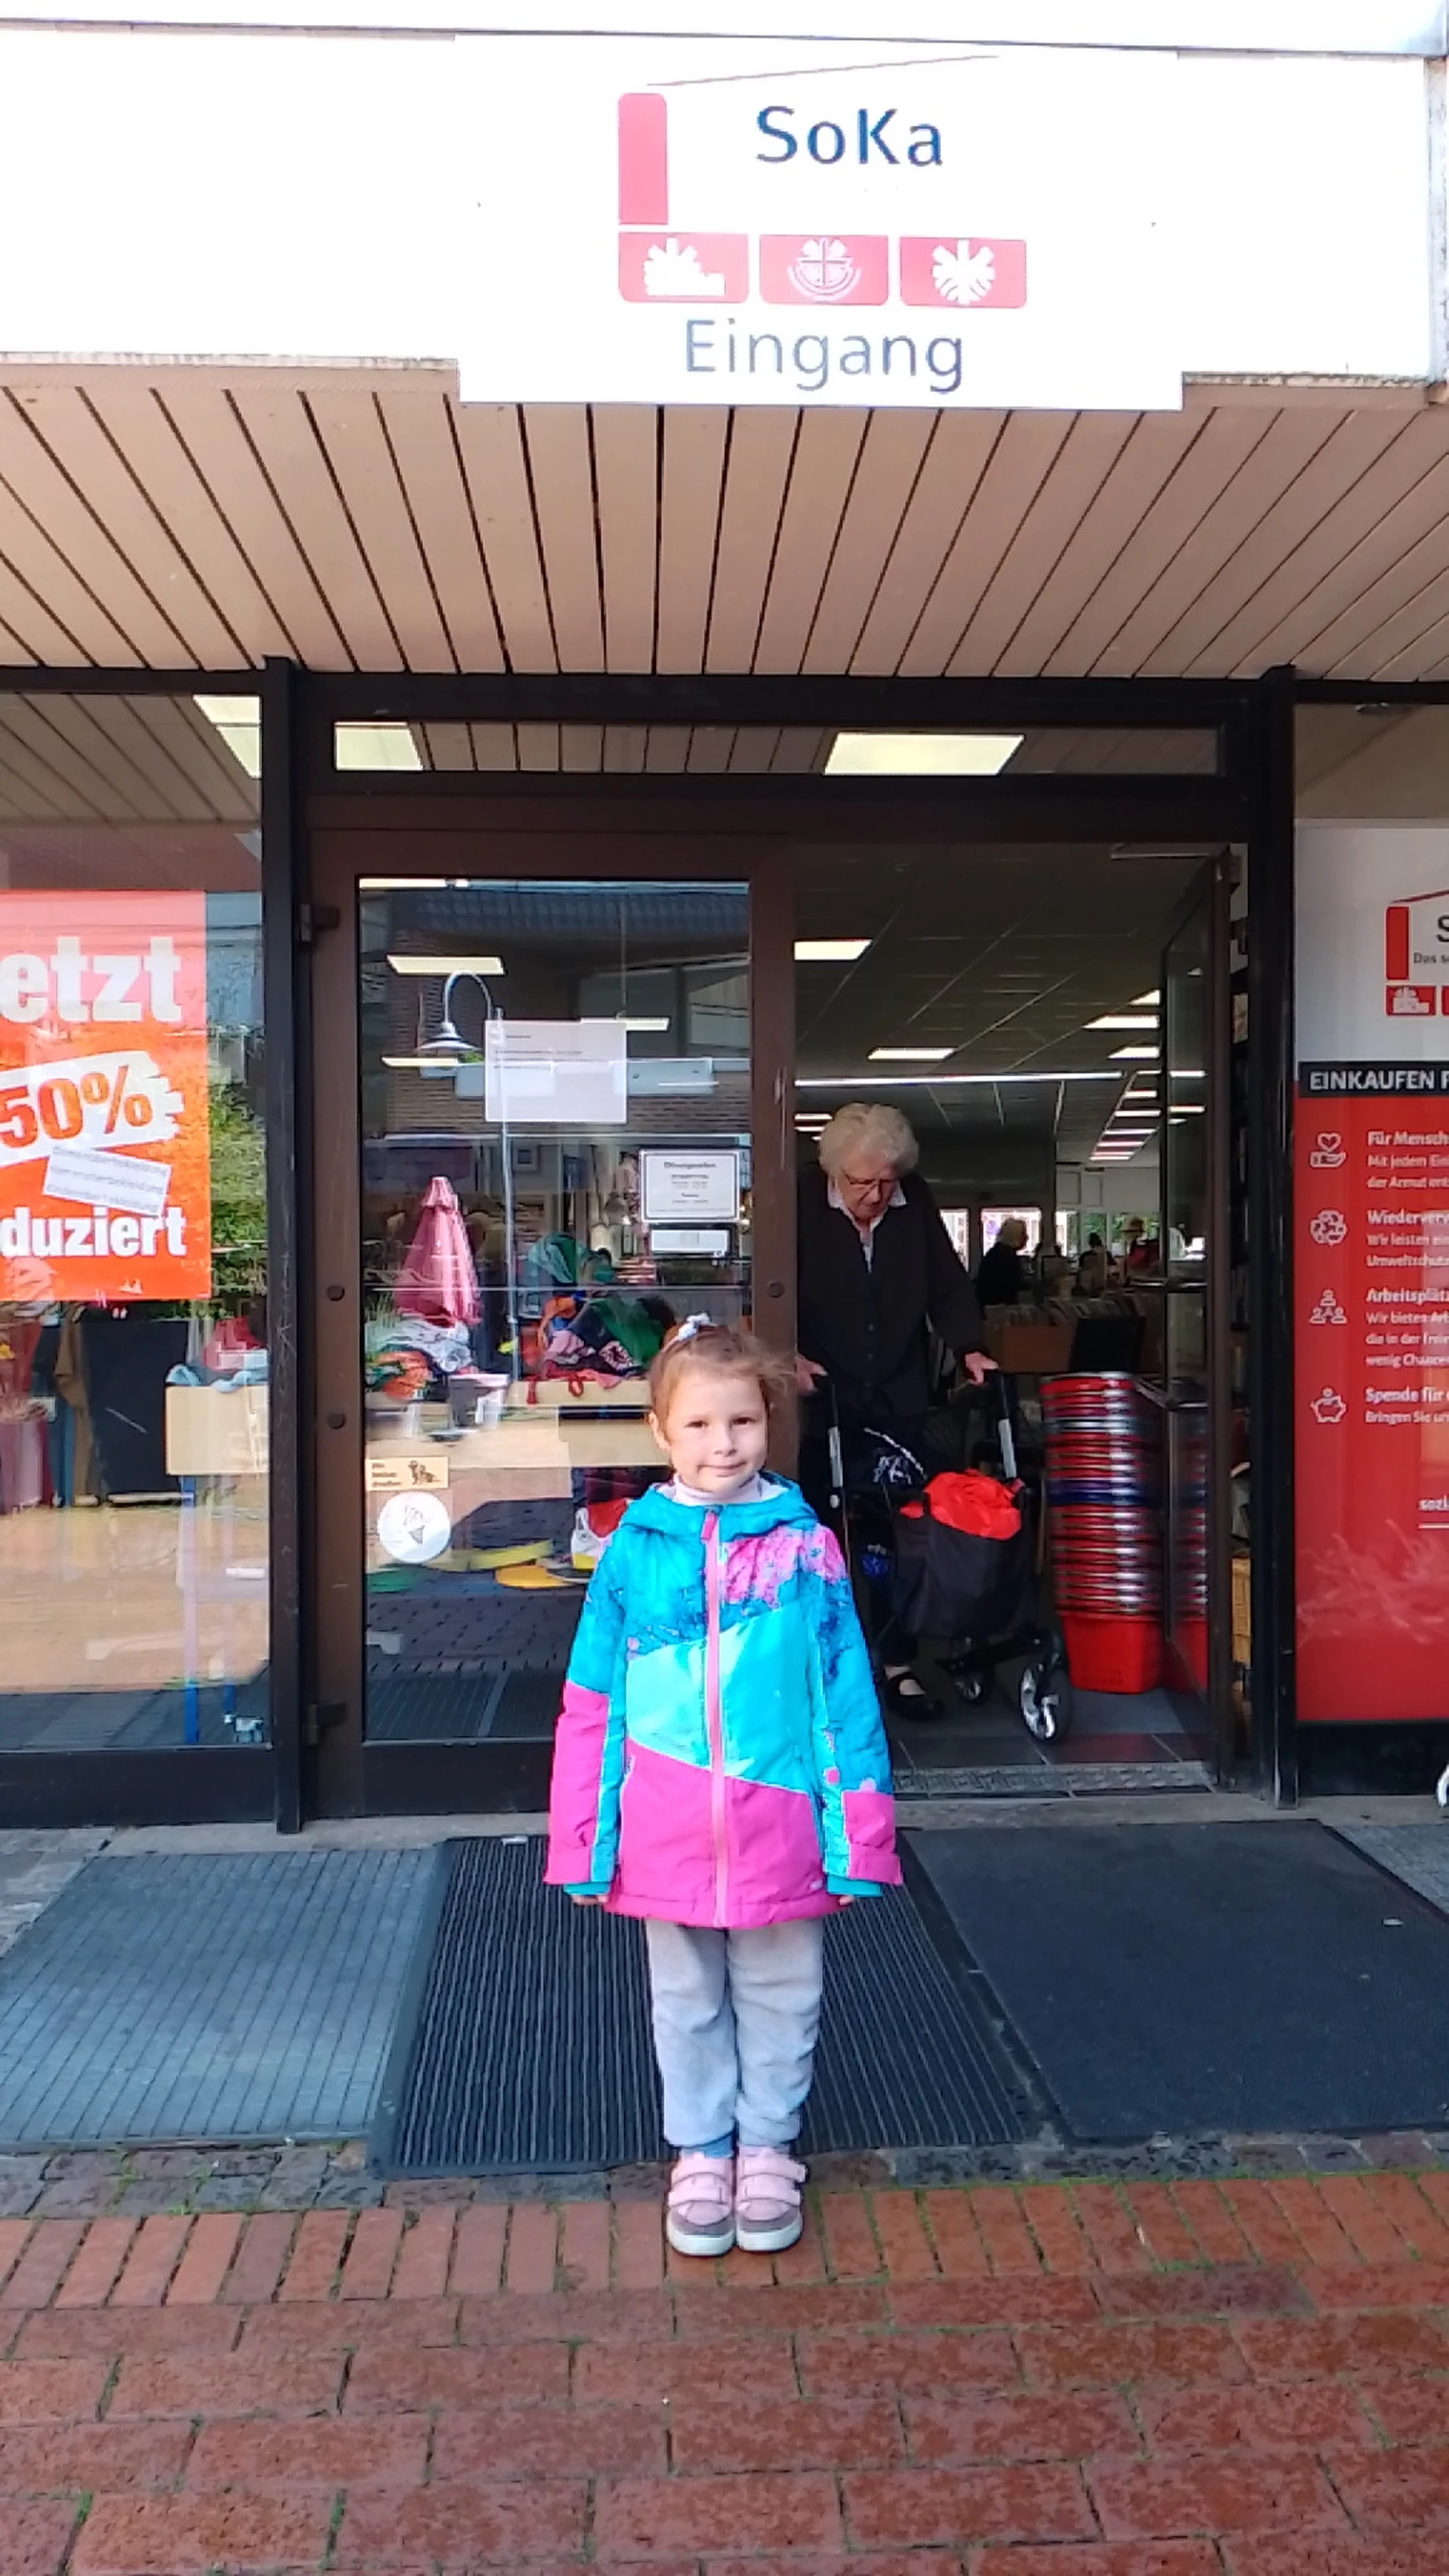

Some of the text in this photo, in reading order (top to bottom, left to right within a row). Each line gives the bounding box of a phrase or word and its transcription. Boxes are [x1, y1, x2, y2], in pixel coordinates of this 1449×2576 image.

[756, 106, 943, 167] SoKa
[686, 318, 962, 394] Eingang
[0, 936, 183, 1023] etzt
[1310, 1070, 1435, 1090] EINKAUFEN
[0, 1065, 154, 1149] 50%
[1367, 1131, 1392, 1146] Für
[0, 1205, 186, 1257] duziert
[1366, 1312, 1388, 1324] Wir
[1365, 1386, 1419, 1404] Spende
